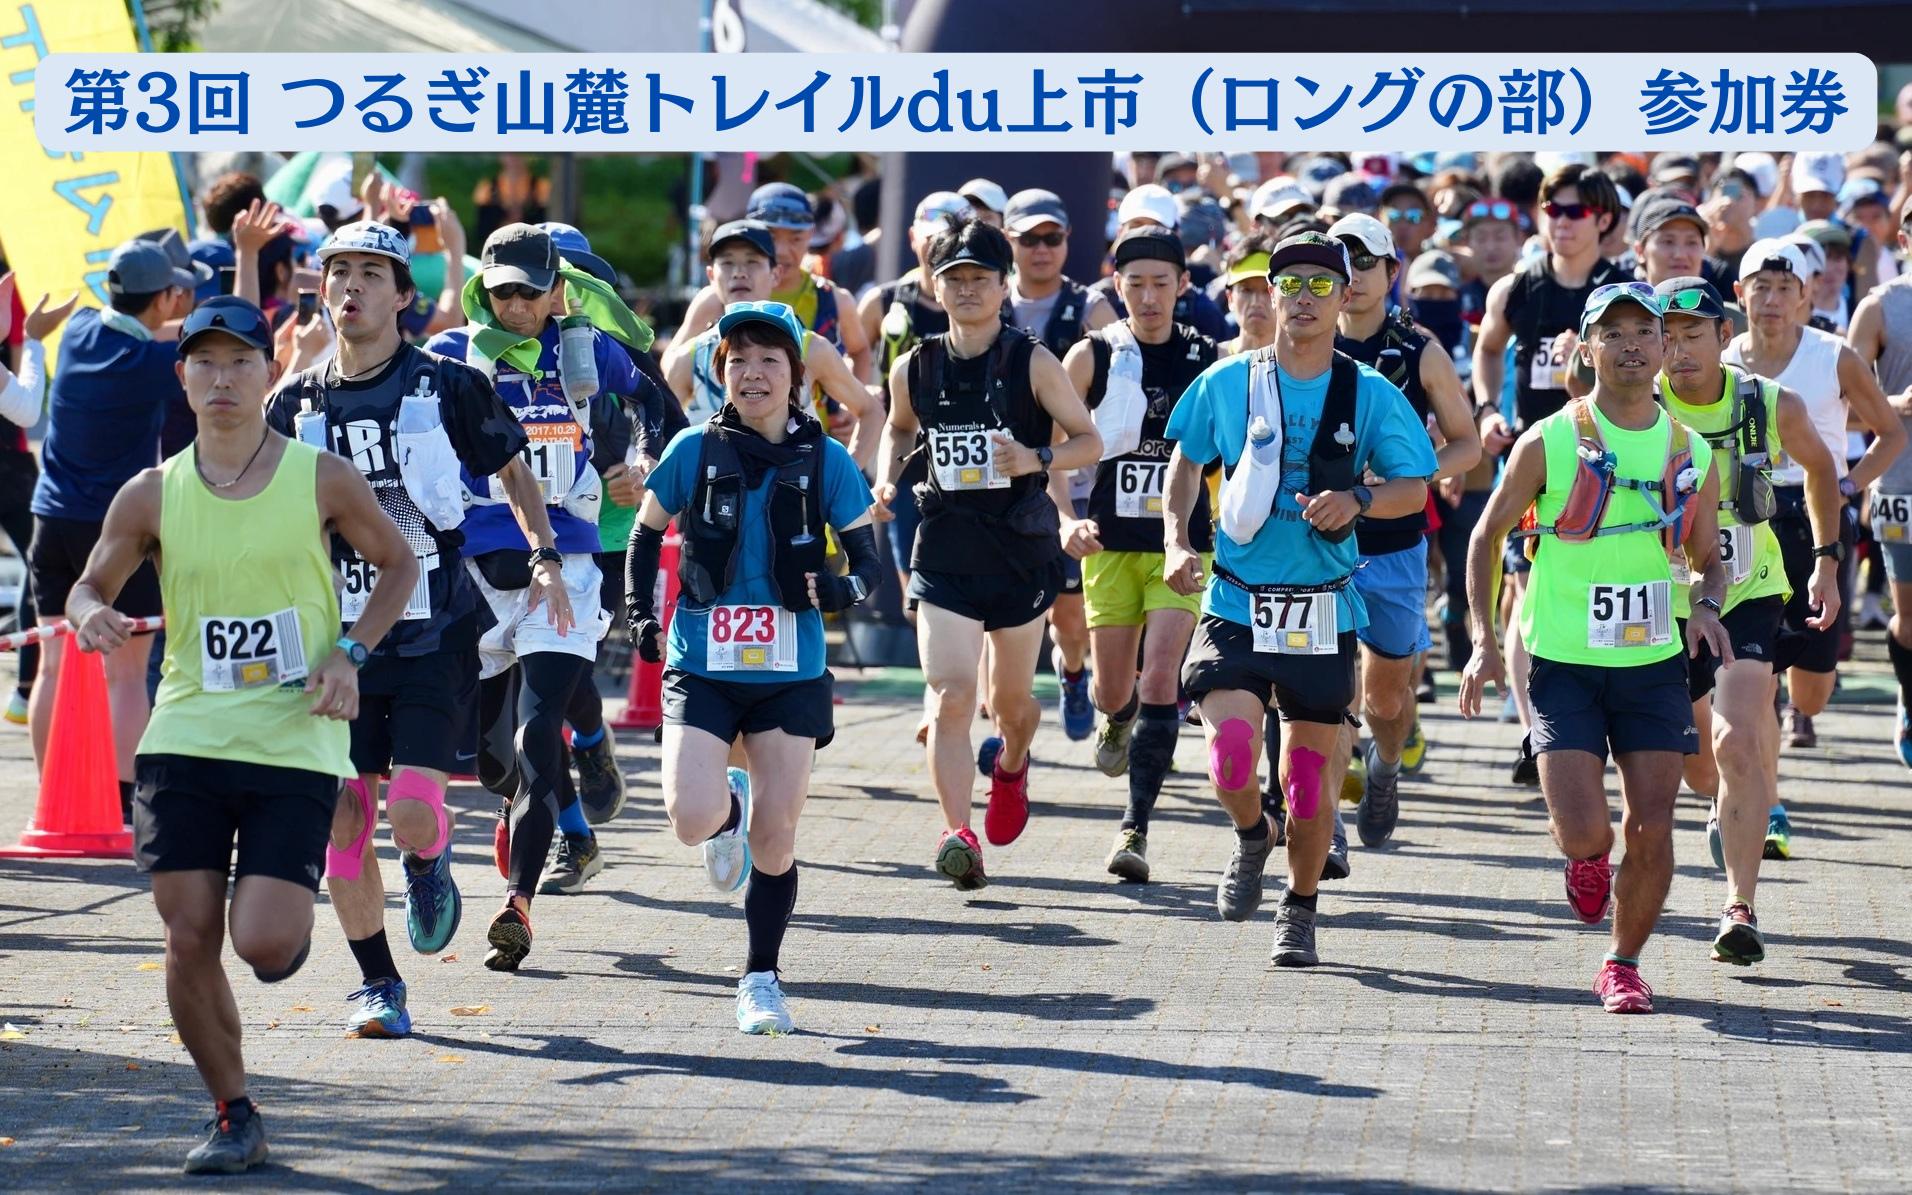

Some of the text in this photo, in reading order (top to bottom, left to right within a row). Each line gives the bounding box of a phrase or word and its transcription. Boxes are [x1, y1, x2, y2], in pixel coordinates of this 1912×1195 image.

[936, 434, 988, 467] 553
[1254, 595, 1313, 629] 577
[1593, 585, 1649, 621] 511
[206, 619, 277, 660] 622
[712, 606, 775, 643] 823
